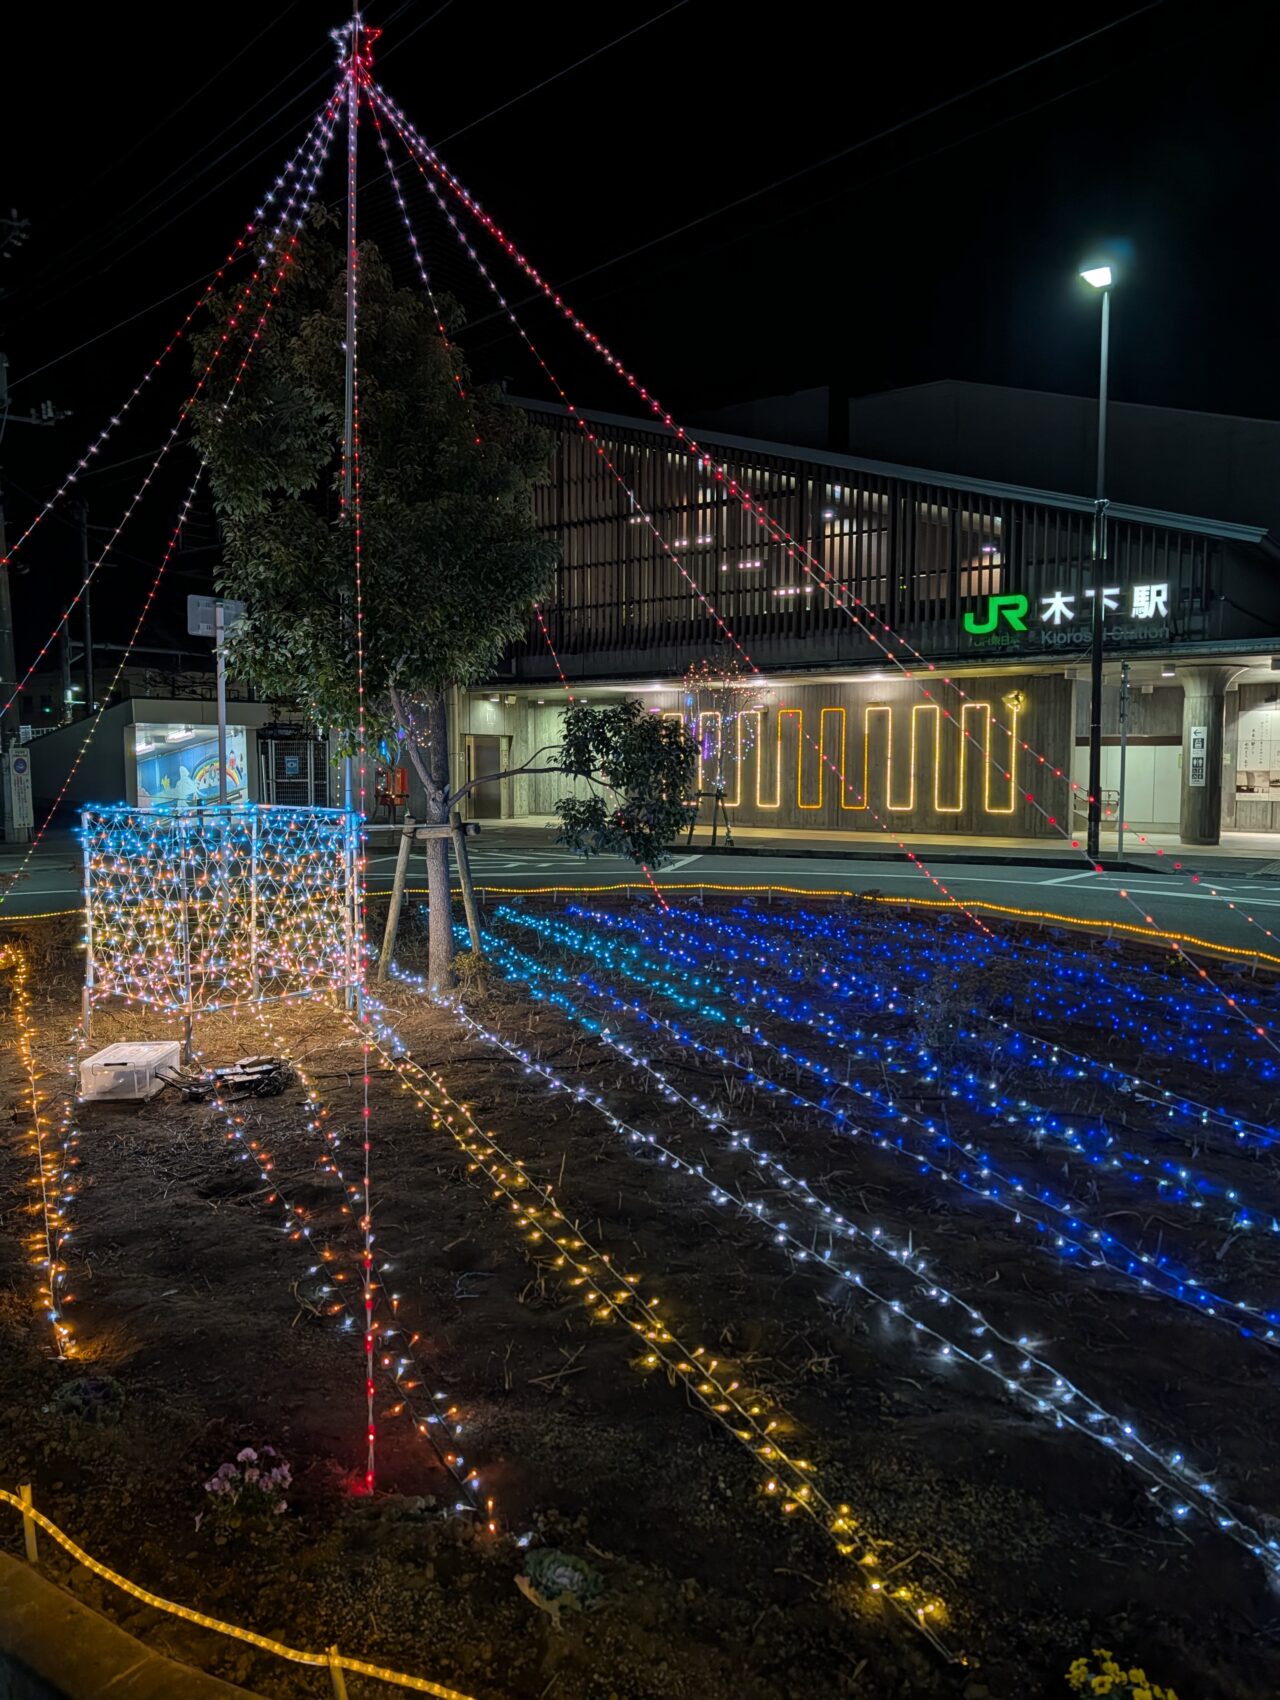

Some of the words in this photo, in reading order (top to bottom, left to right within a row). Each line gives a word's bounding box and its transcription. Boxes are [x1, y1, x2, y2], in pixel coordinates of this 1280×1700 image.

[964, 594, 1028, 635] JR
[1040, 582, 1169, 626] 木下駅
[1041, 628, 1107, 646] Kiorosi
